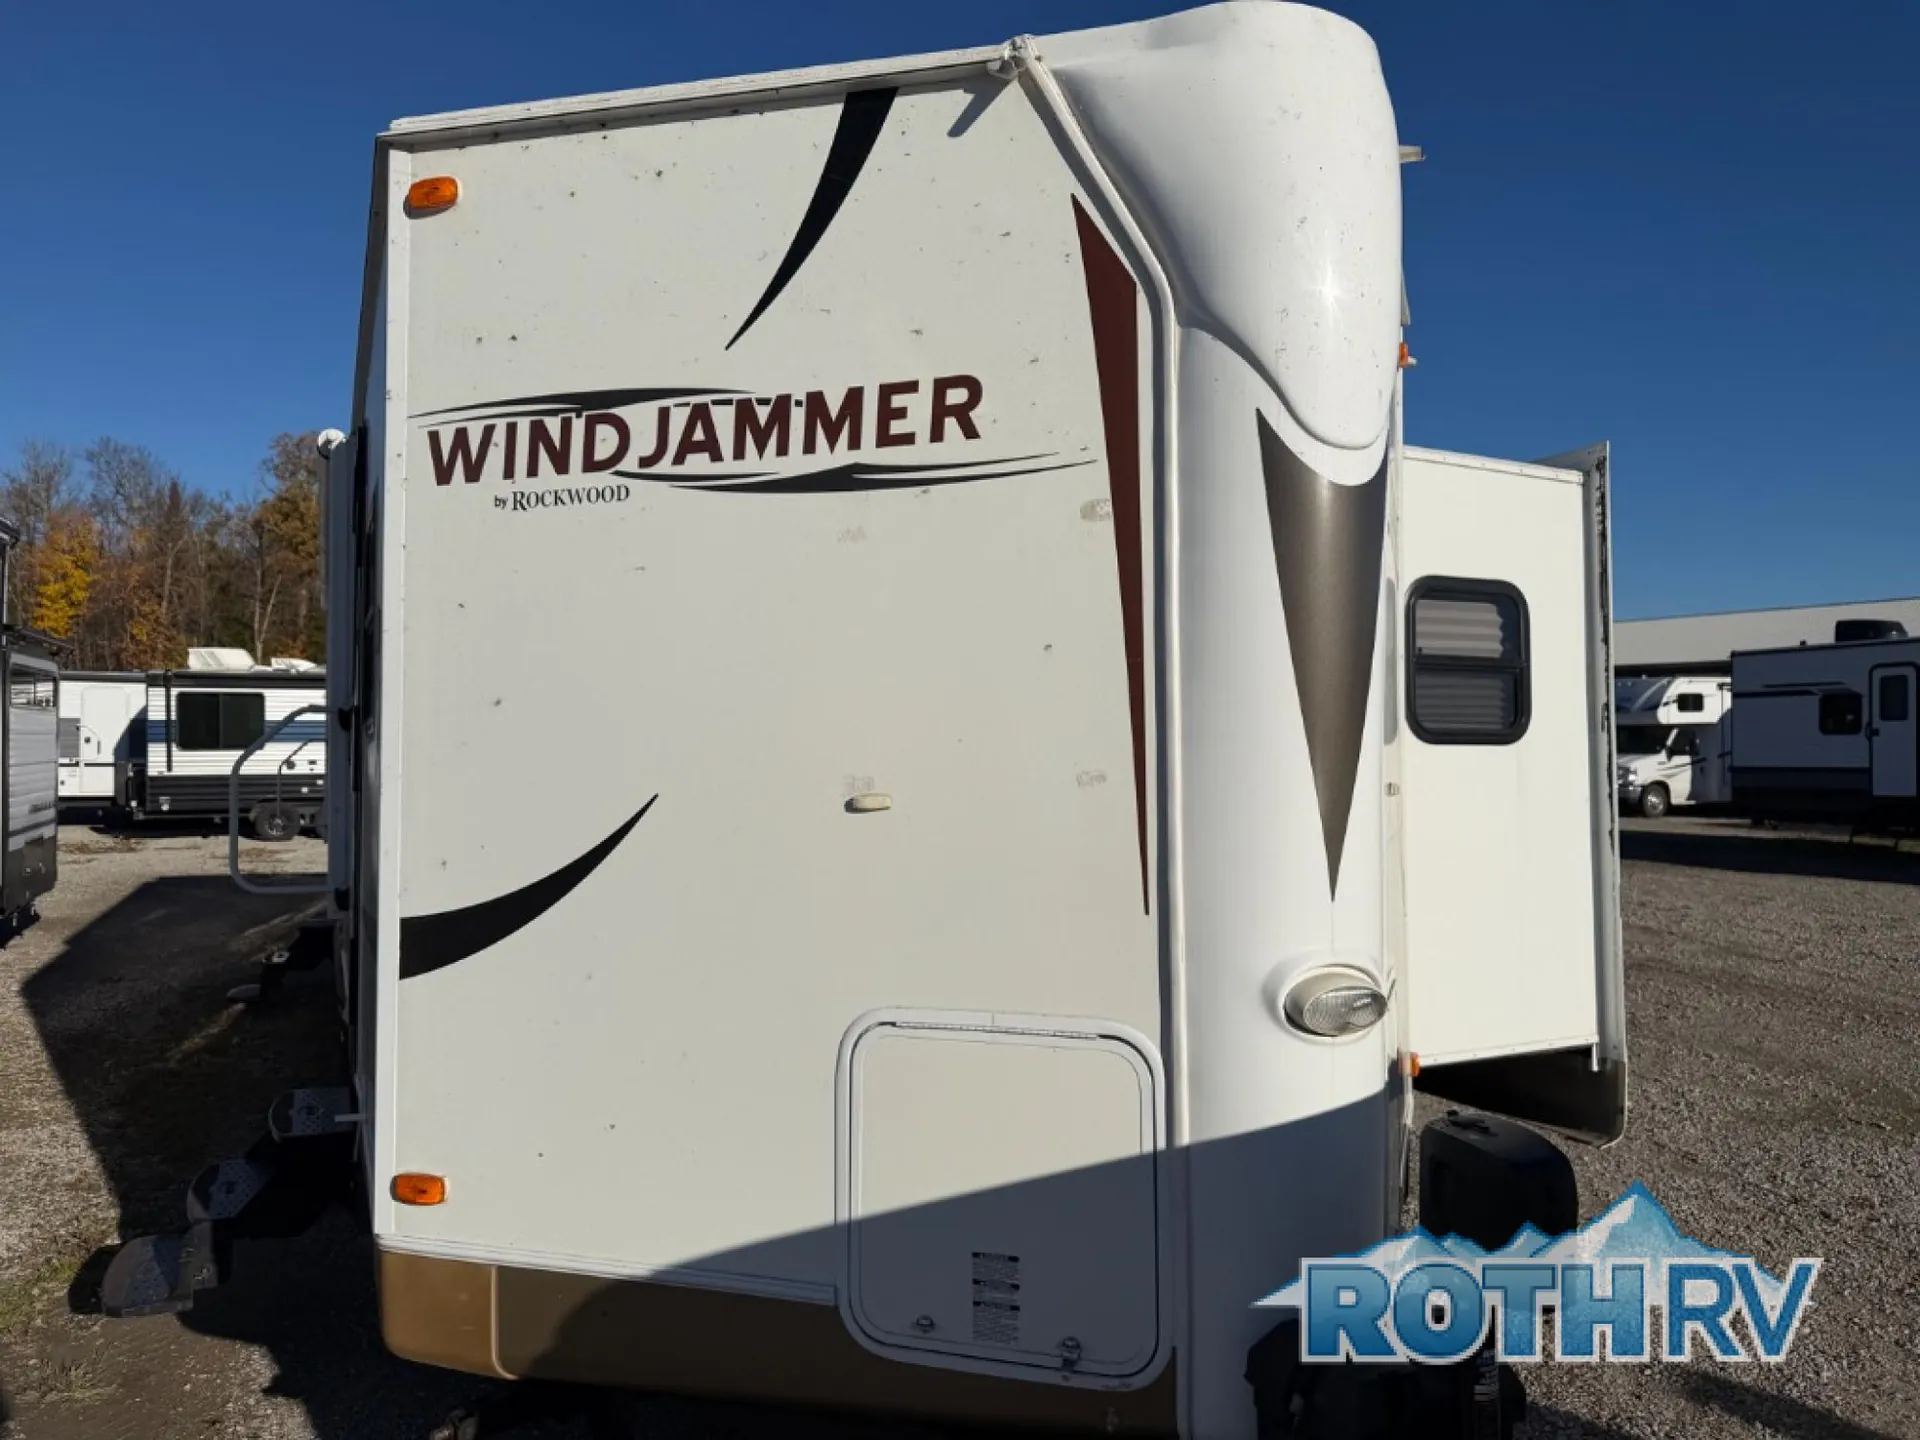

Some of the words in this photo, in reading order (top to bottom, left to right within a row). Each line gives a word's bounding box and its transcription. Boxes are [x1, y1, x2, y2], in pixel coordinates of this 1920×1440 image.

[427, 373, 984, 488] WINDJAMMER
[494, 494, 508, 510] by
[511, 484, 631, 512] ROCKWOOD
